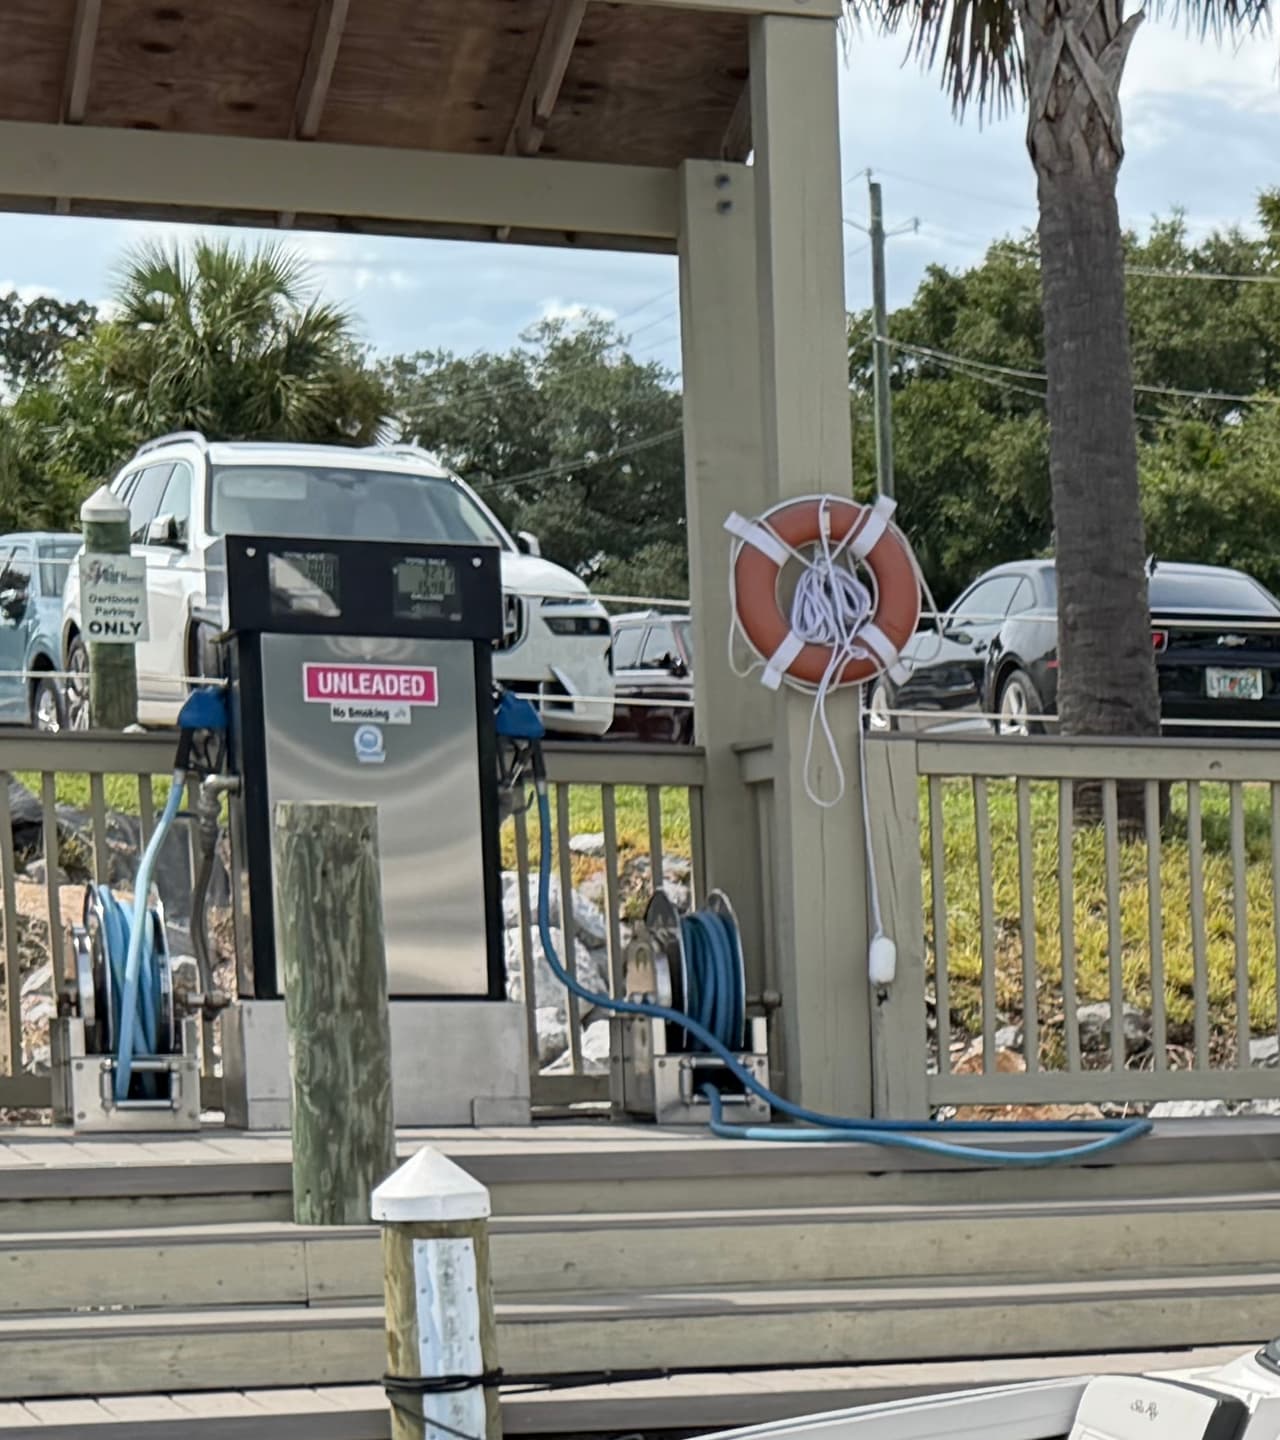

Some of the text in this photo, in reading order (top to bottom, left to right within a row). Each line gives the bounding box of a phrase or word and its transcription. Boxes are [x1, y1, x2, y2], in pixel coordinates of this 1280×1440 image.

[88, 621, 142, 636] ONLY
[318, 671, 426, 697] UNLEADED
[333, 707, 390, 722] No Smoking
